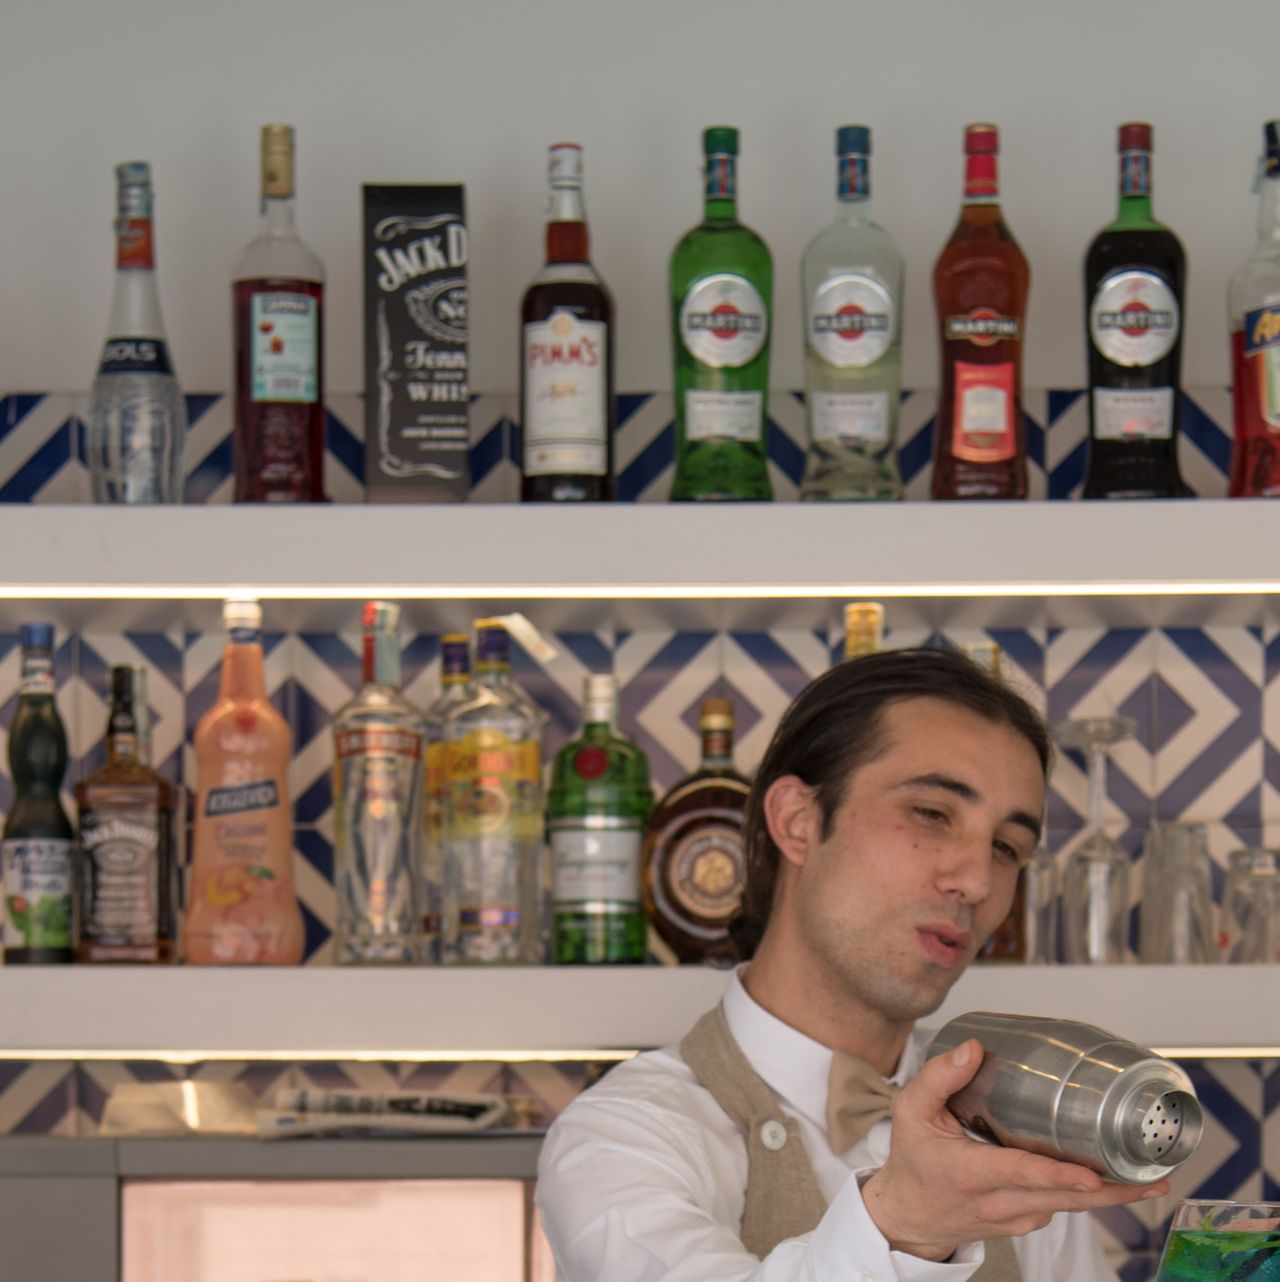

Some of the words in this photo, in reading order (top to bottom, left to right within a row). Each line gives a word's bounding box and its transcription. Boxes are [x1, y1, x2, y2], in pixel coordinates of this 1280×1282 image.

[375, 234, 441, 292] JACK
[688, 315, 760, 332] MARTINI
[815, 316, 887, 333] MARTINI
[949, 317, 1018, 334] MARTINI
[1100, 311, 1171, 328] MARTINI
[528, 335, 599, 369] PIMM'S
